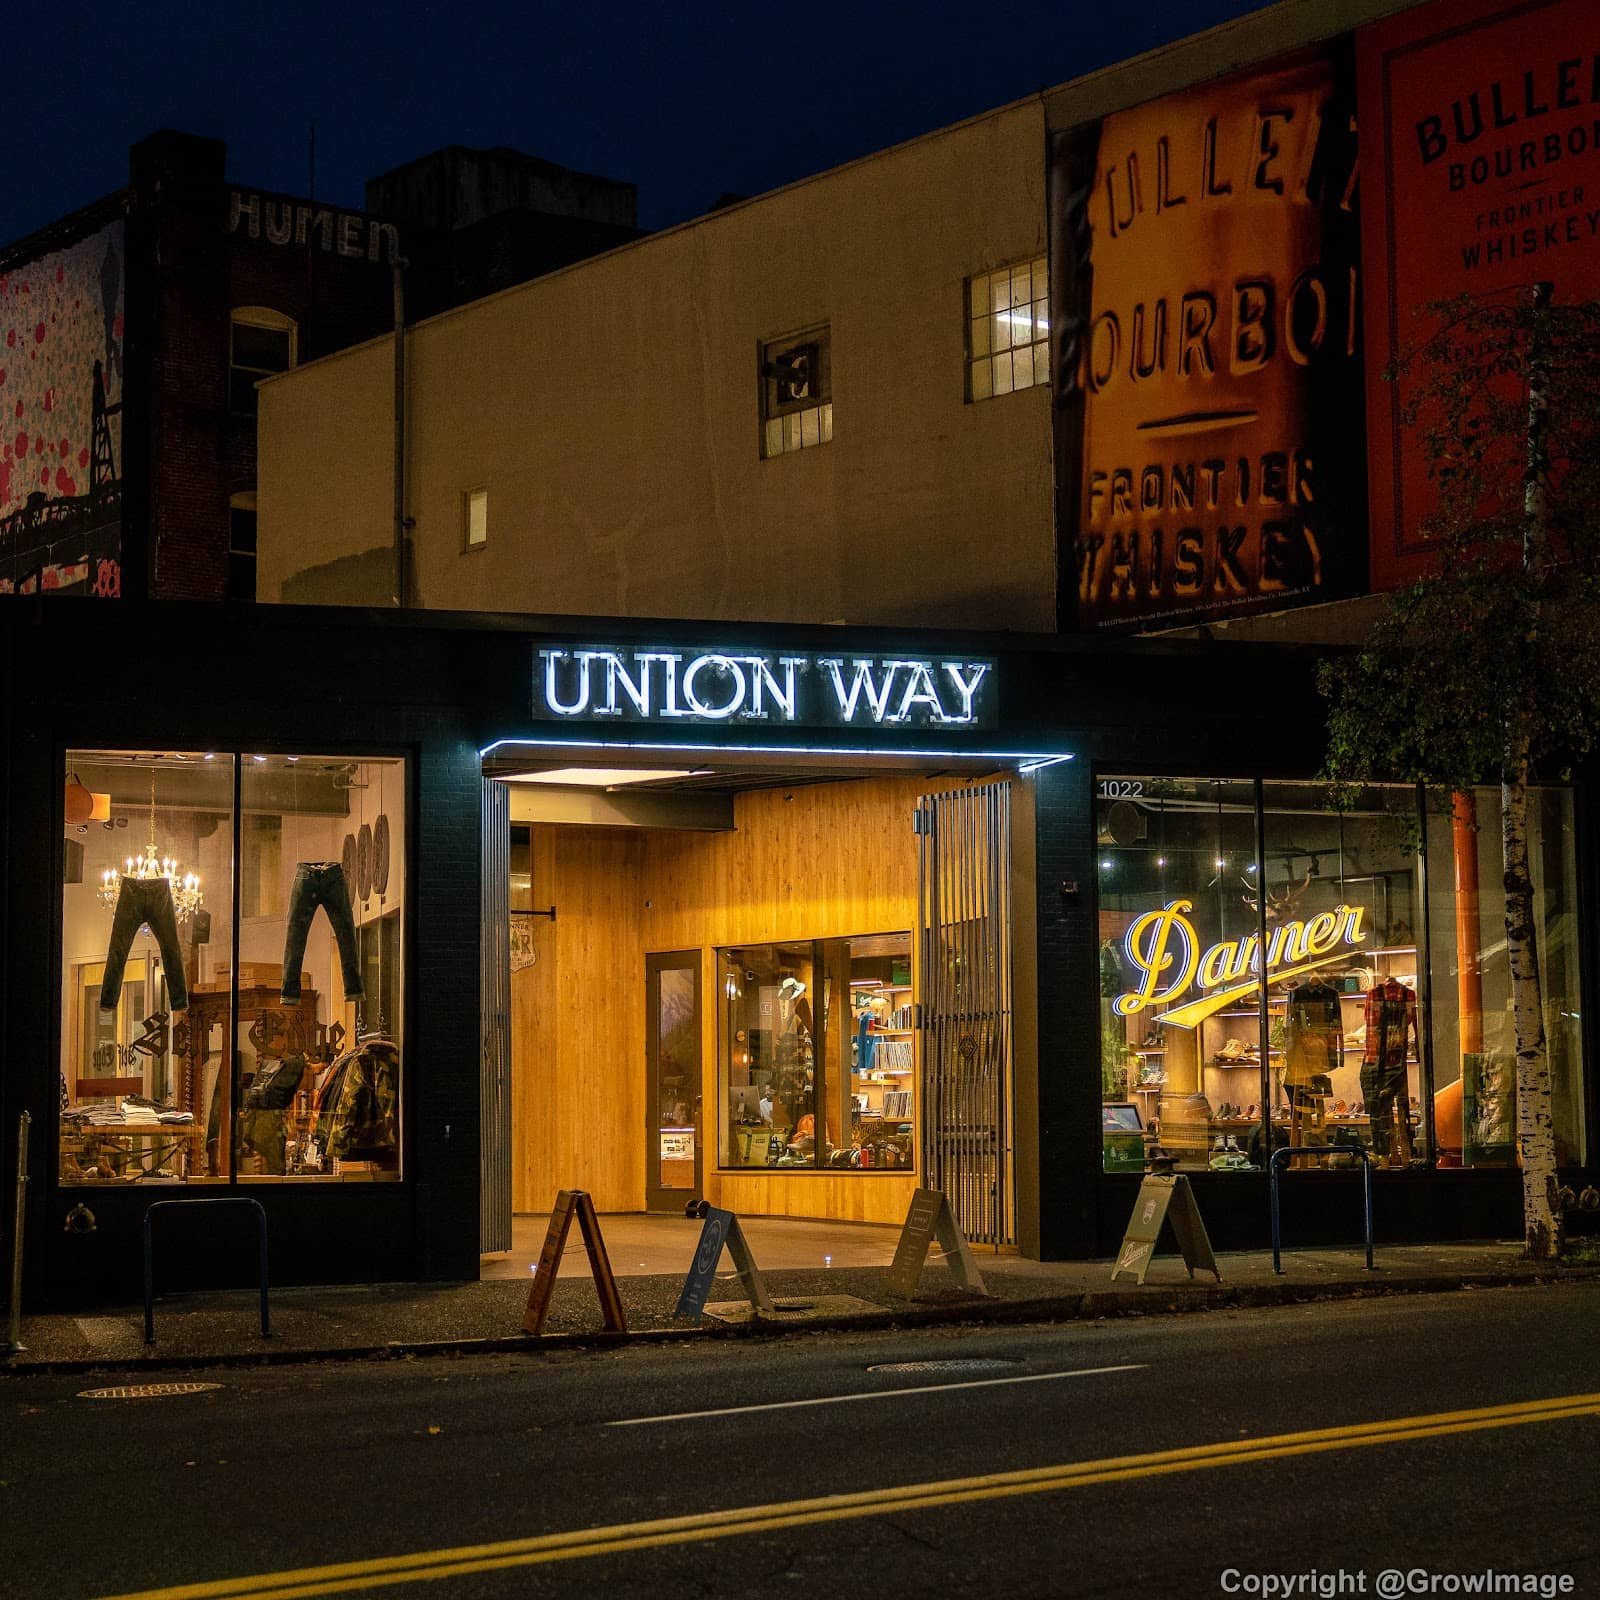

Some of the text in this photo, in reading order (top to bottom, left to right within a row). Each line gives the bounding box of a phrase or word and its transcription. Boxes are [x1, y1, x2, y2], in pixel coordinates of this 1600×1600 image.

[1462, 208, 1600, 271] WHISKEY
[1475, 186, 1585, 233] FRONTIER
[1087, 450, 1316, 526] FRONTIER
[538, 648, 993, 724] UNION WAY
[1100, 780, 1143, 798] 1022
[1112, 899, 1367, 1017] Danner
